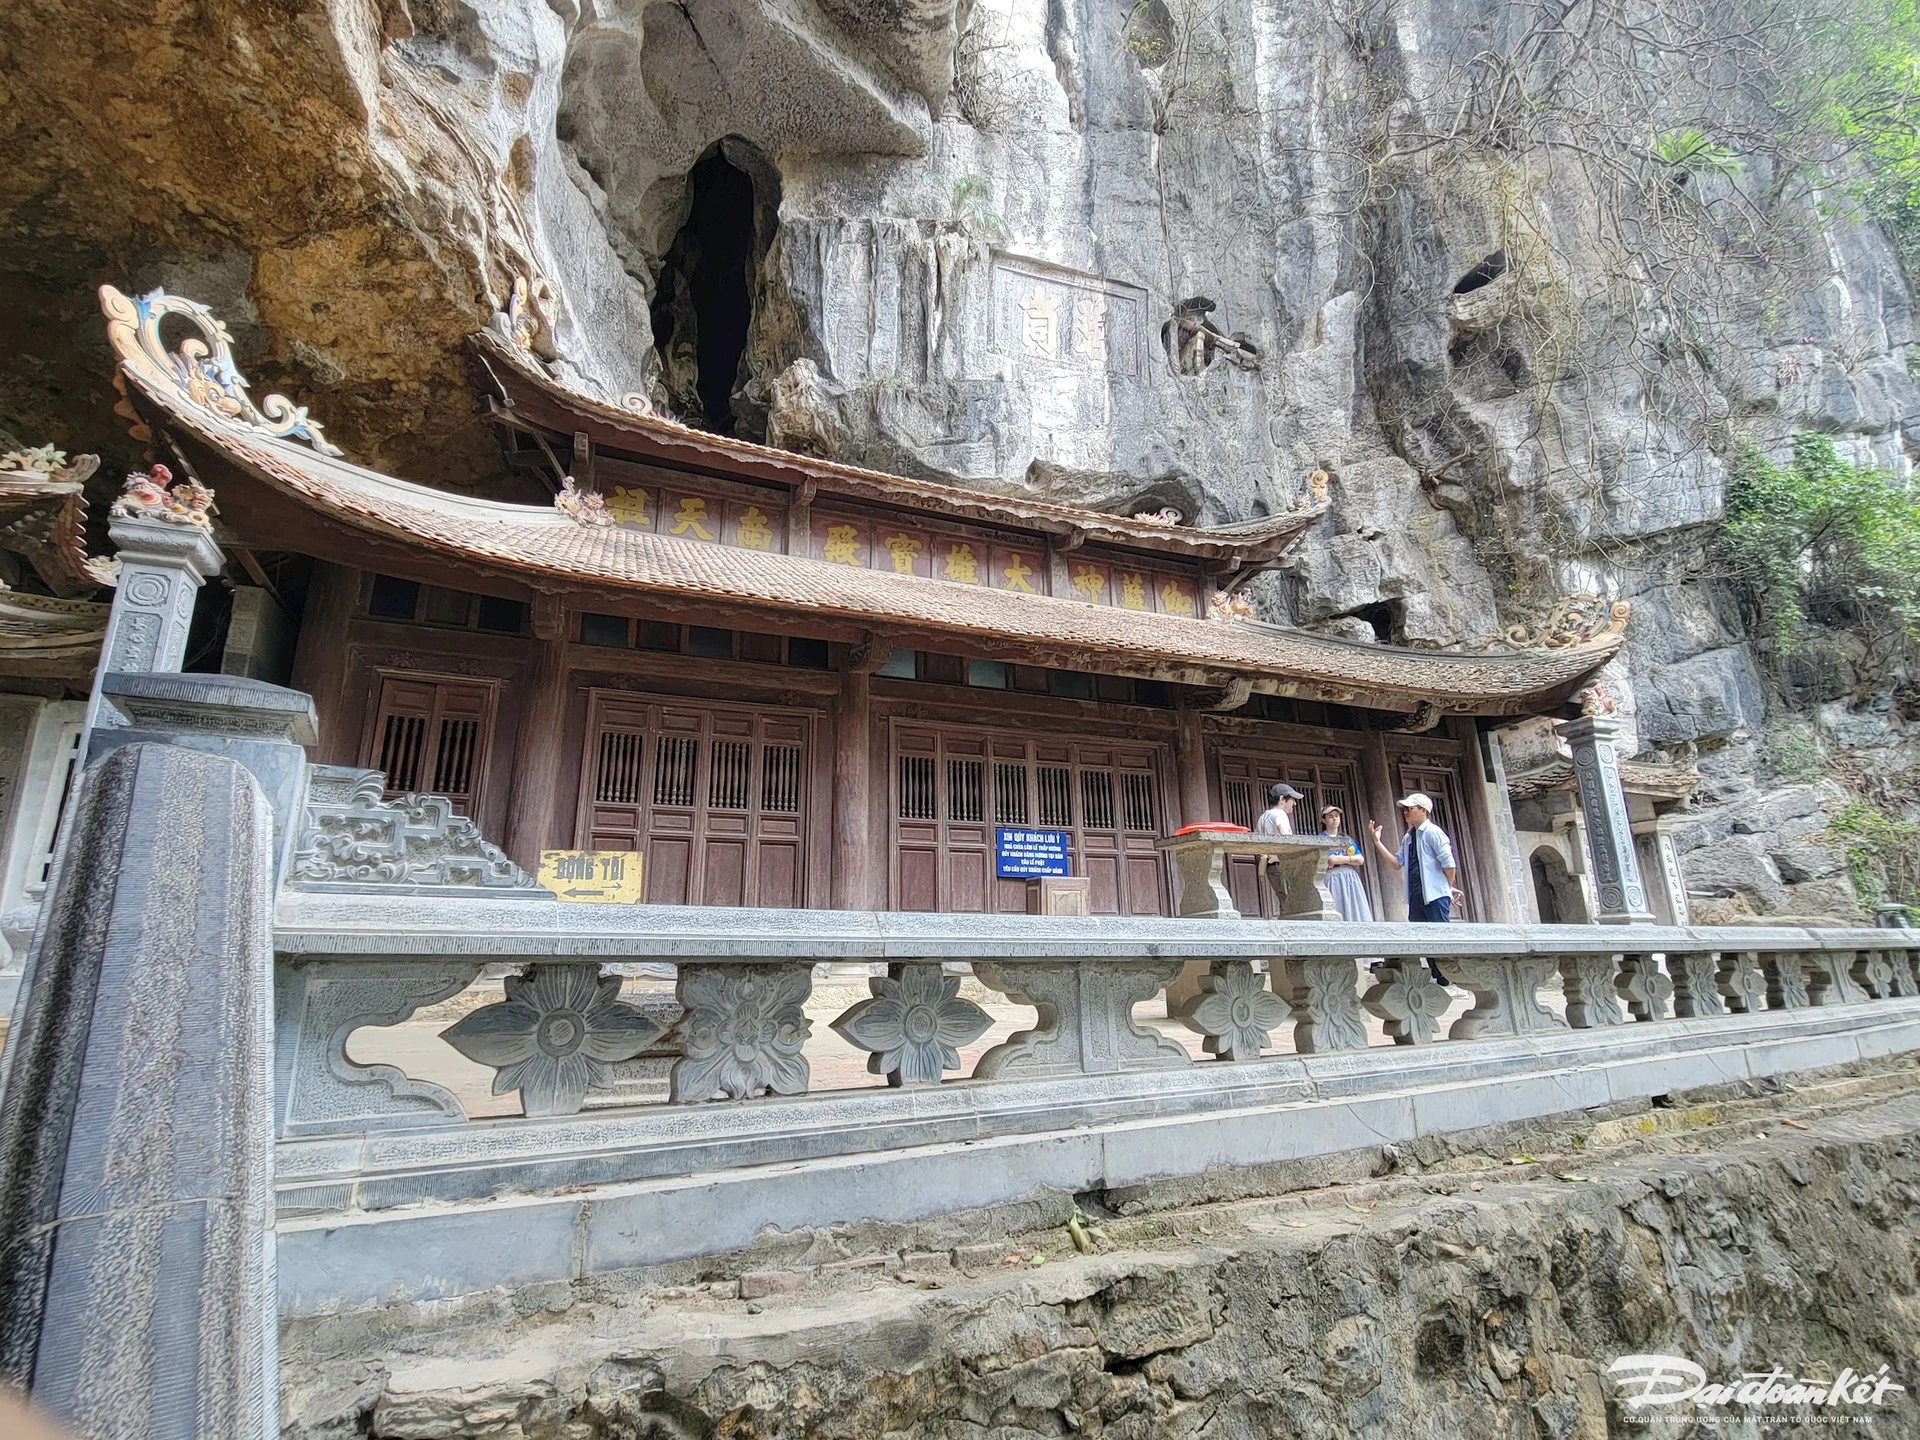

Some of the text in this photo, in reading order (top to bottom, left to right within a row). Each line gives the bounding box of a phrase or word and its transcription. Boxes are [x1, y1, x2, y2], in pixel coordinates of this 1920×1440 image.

[1004, 832, 1013, 841] XIN
[1026, 832, 1043, 842] KHÁCH
[1056, 834, 1060, 843] Ý
